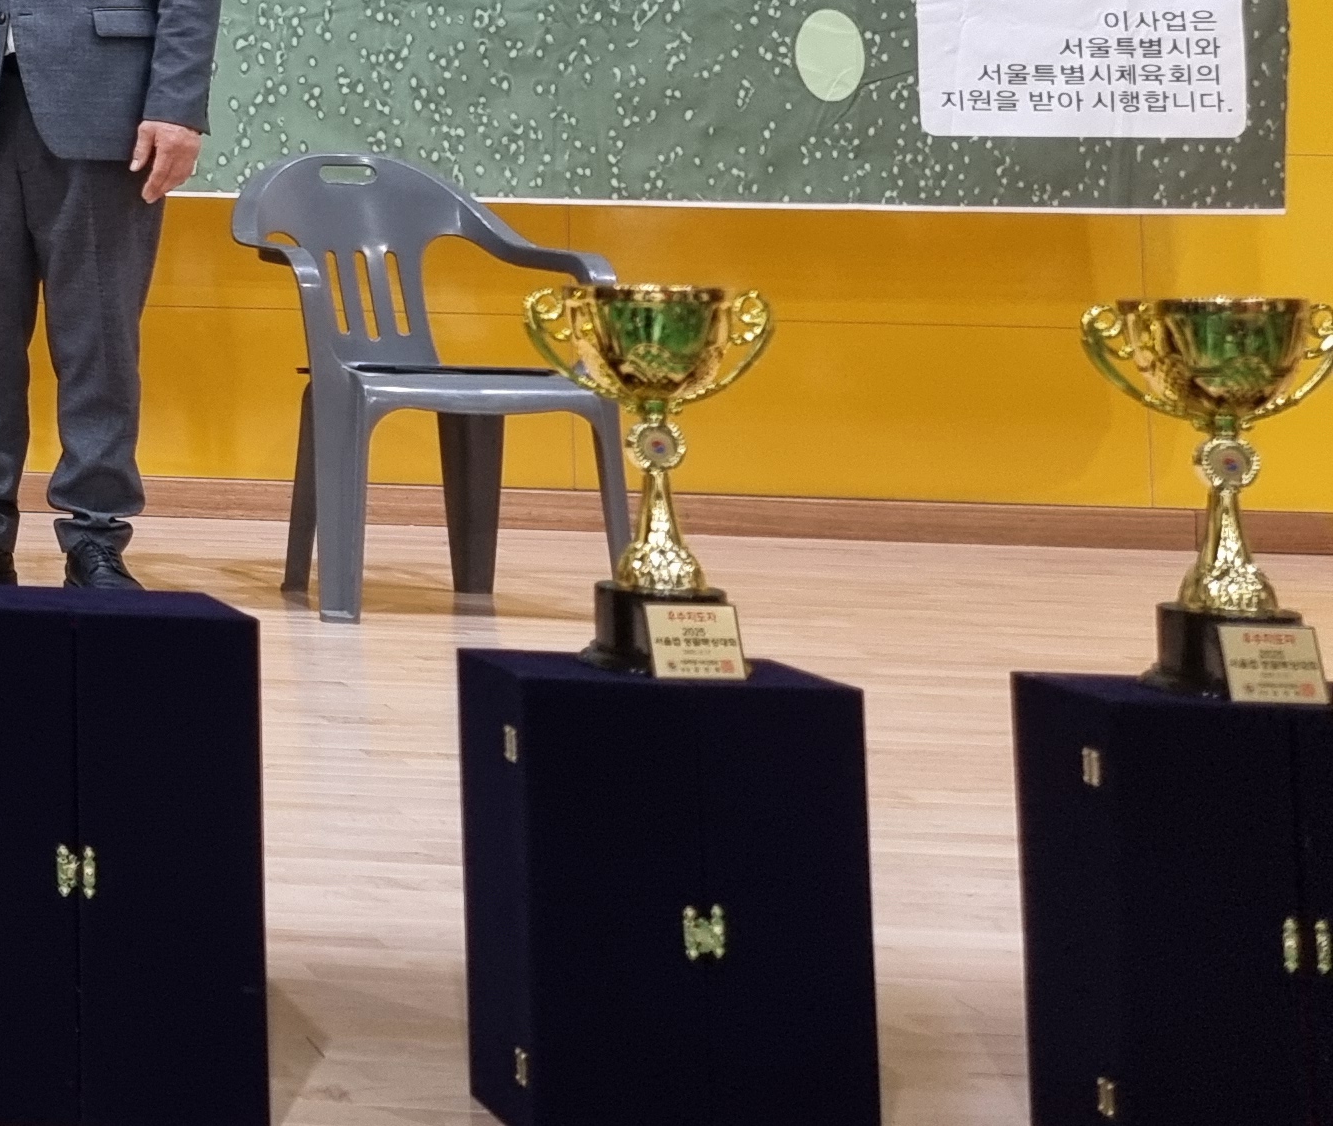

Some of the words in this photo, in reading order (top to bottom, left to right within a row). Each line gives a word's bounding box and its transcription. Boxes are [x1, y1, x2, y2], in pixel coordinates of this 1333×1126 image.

[1059, 37, 1221, 59] 서울특별시와
[977, 63, 1221, 85] 서울특별시체육회의
[941, 89, 1020, 112] 지원을
[1029, 90, 1084, 112] 받아
[1092, 90, 1233, 113] 시행합니다.
